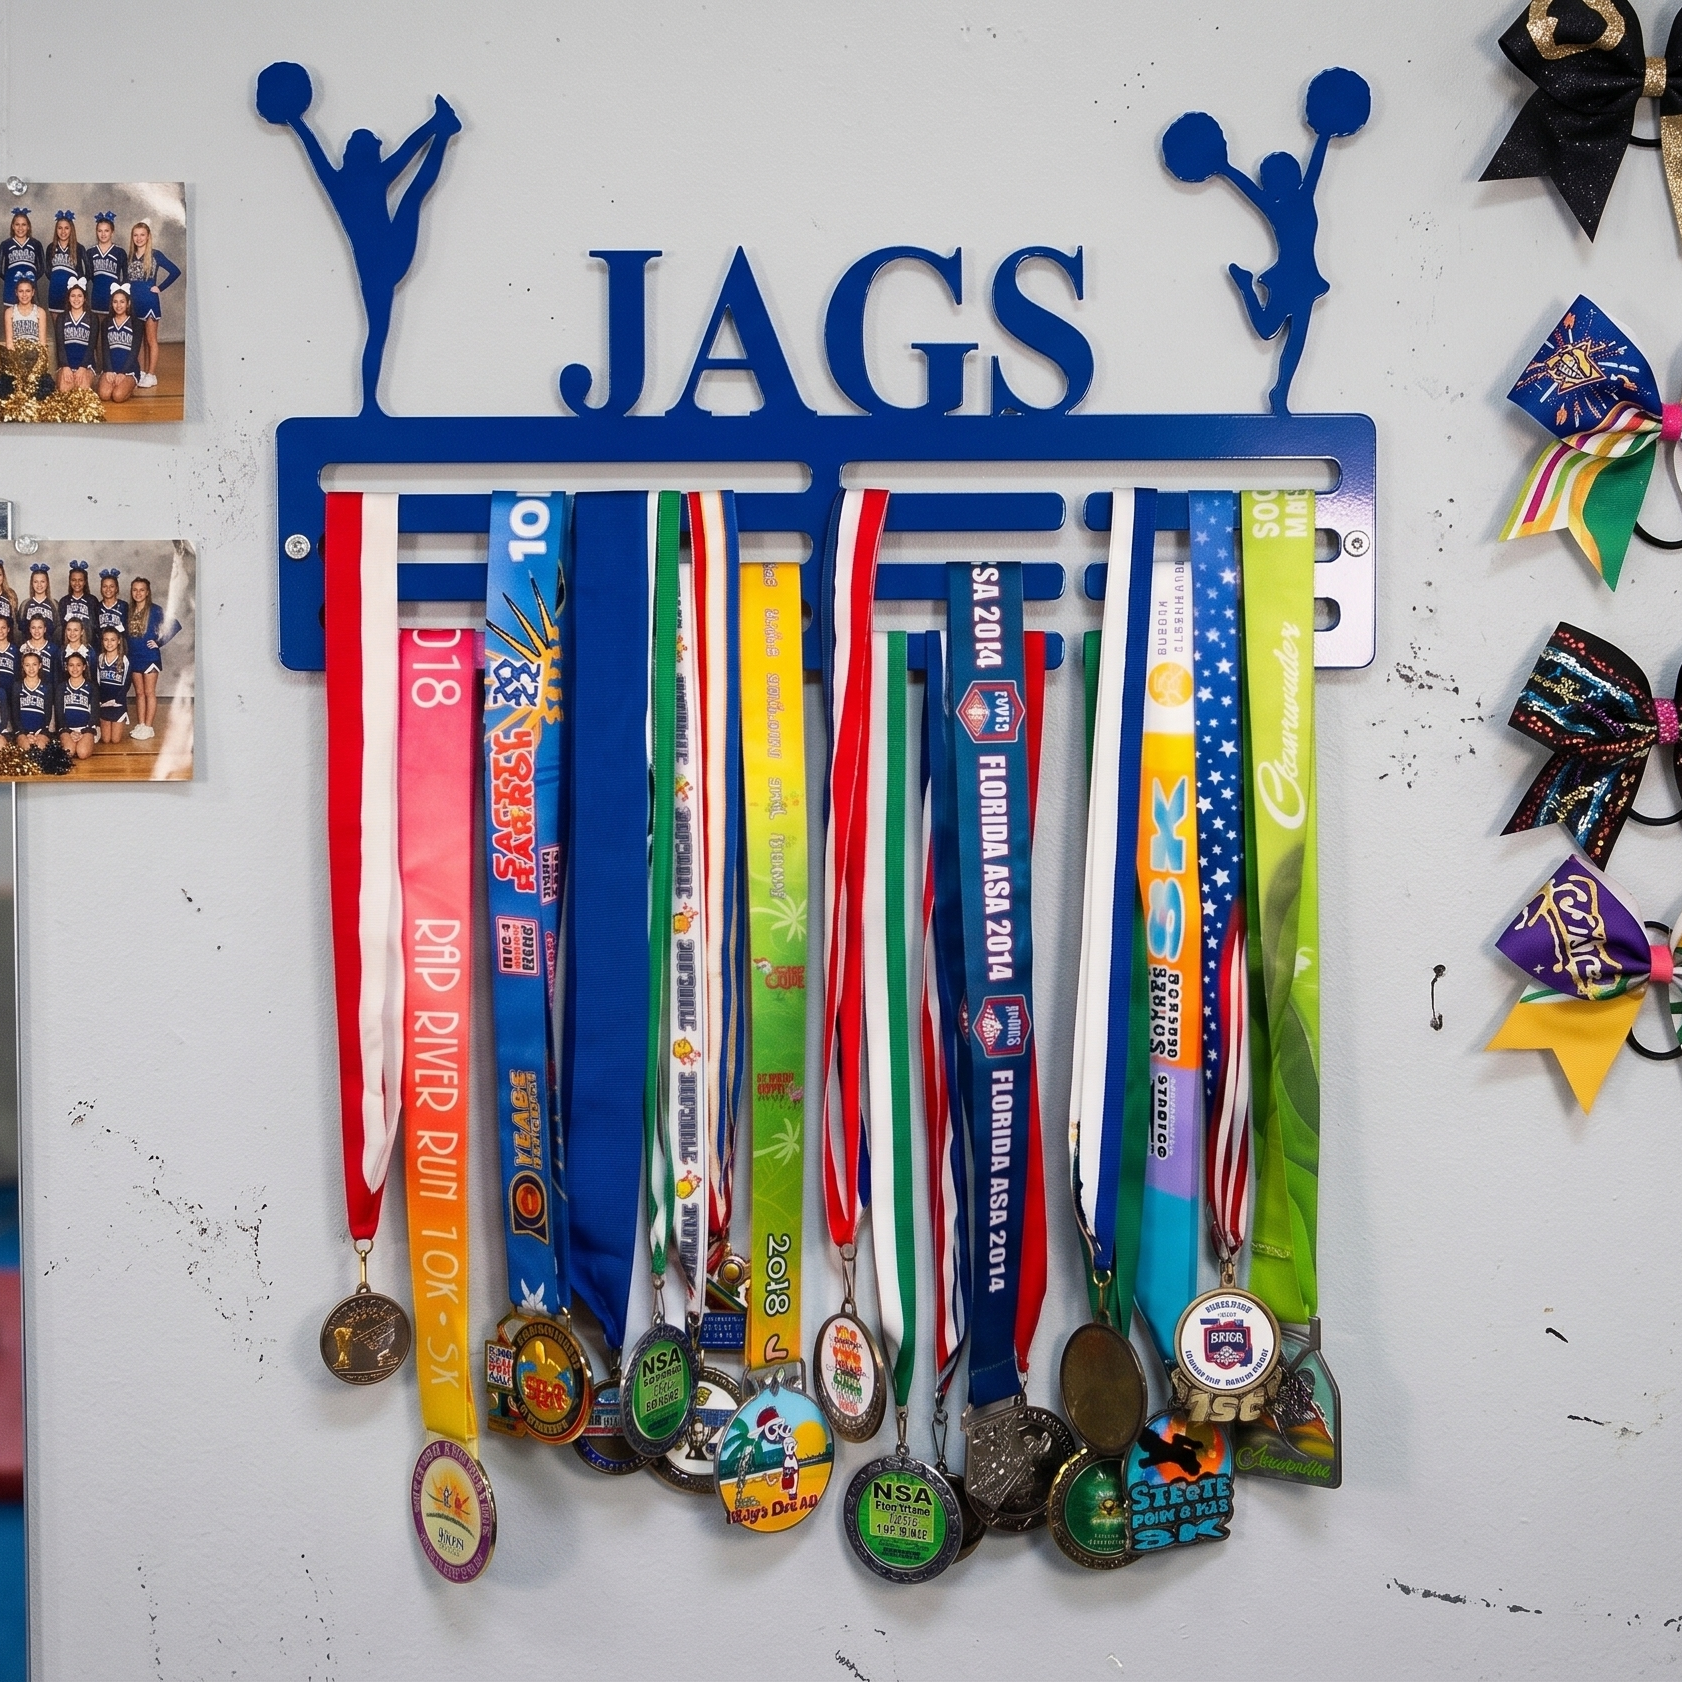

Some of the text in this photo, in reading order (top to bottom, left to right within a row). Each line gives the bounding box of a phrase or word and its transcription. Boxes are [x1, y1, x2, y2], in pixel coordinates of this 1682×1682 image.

[559, 245, 1095, 417] JAGS
[974, 605, 1002, 668] 2014
[978, 755, 1008, 860] FLORIDA
[983, 861, 1010, 915] ASA
[986, 915, 1013, 982] 2014
[414, 1010, 459, 1112] RIVER
[991, 1069, 1014, 1172] FLORIDA
[415, 1130, 459, 1201] RUN
[989, 1177, 1009, 1227] ASA
[421, 1225, 460, 1305] 10K
[766, 1234, 792, 1317] 2018
[988, 1229, 1007, 1293] 2014
[642, 1346, 682, 1379] NSA
[873, 1481, 933, 1506] NSA
